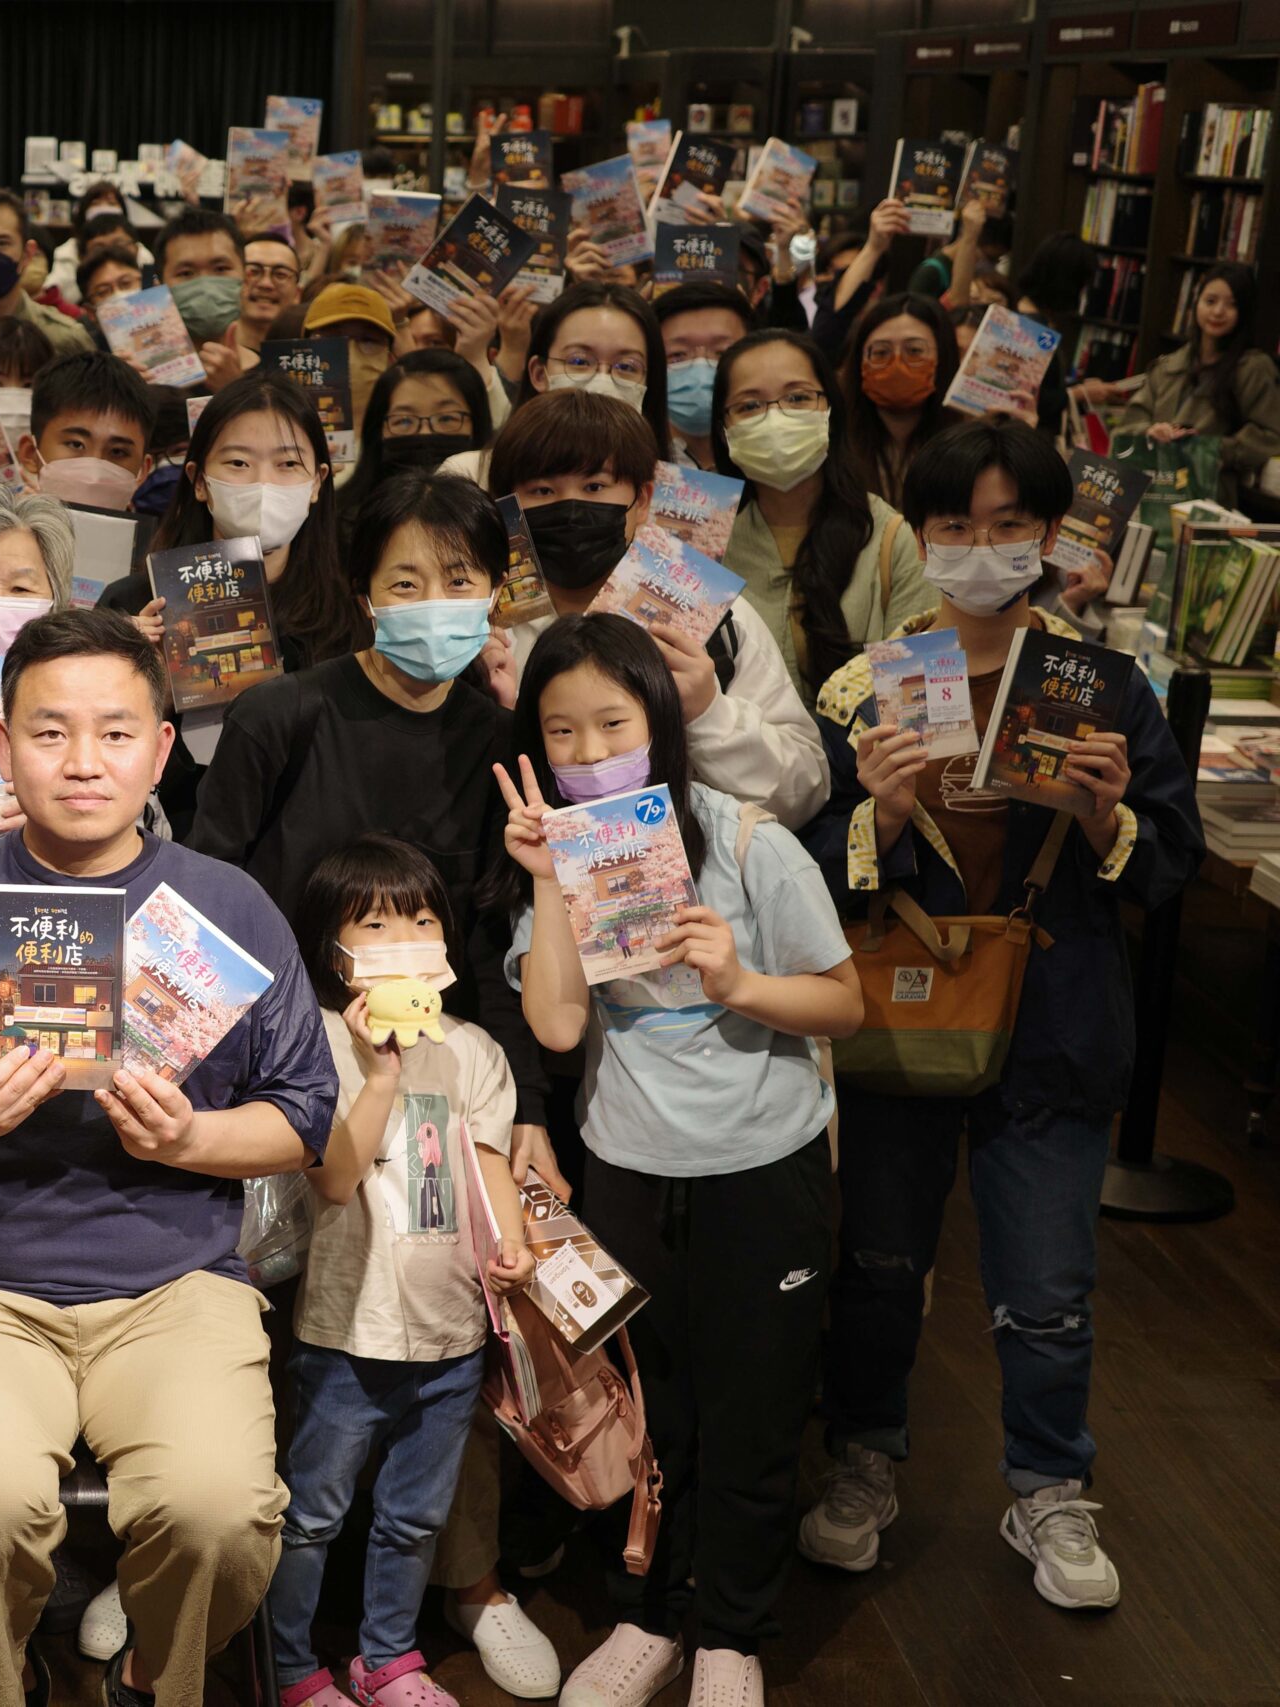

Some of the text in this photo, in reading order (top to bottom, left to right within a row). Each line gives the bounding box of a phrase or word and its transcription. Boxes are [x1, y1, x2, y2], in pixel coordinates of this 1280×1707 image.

[942, 687, 952, 701] 8
[15, 940, 84, 967] 便利店
[785, 1267, 811, 1283] NIKE
